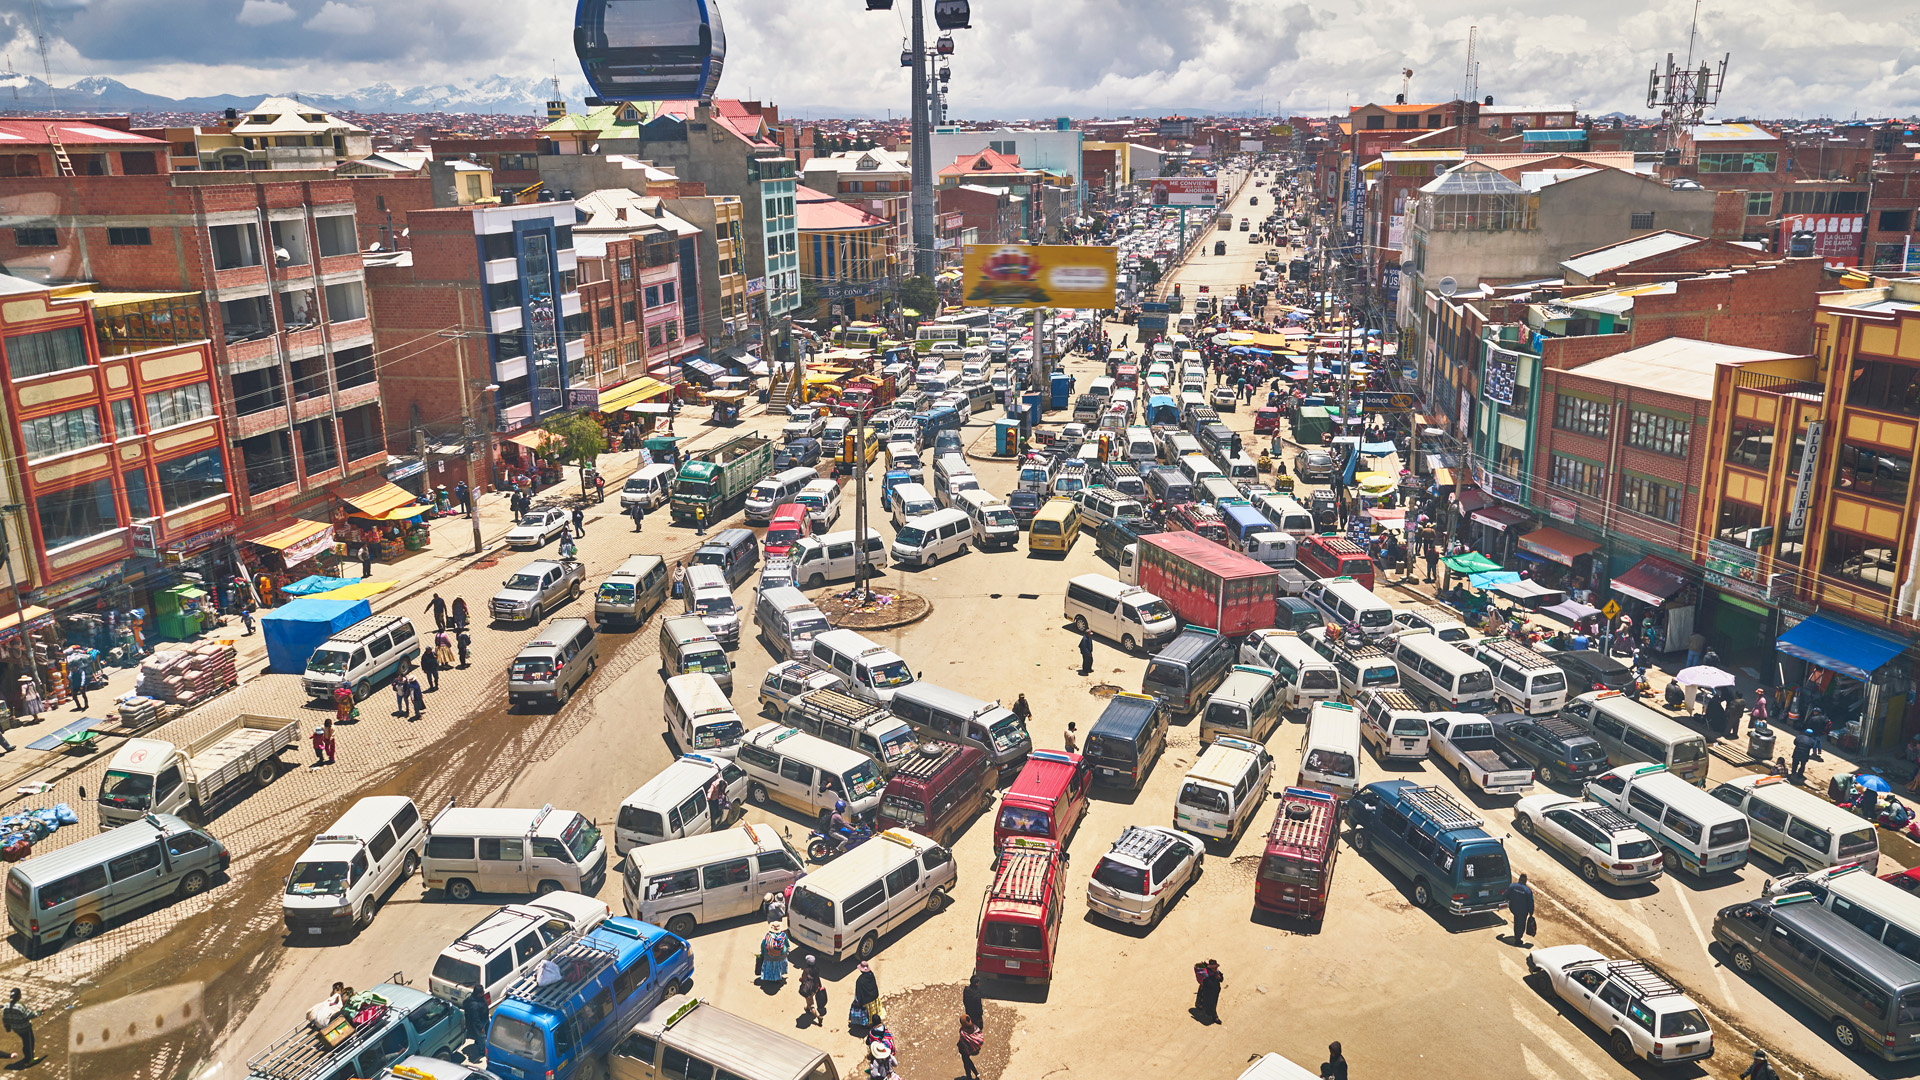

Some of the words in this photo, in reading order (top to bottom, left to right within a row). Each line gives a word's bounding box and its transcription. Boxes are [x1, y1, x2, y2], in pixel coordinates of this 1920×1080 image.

[1355, 183, 1365, 254] EMERGENCIAS
[828, 288, 863, 296] BacoSol
[1366, 396, 1388, 404] banco
[1795, 427, 1820, 527] ALOJAMIENTO
